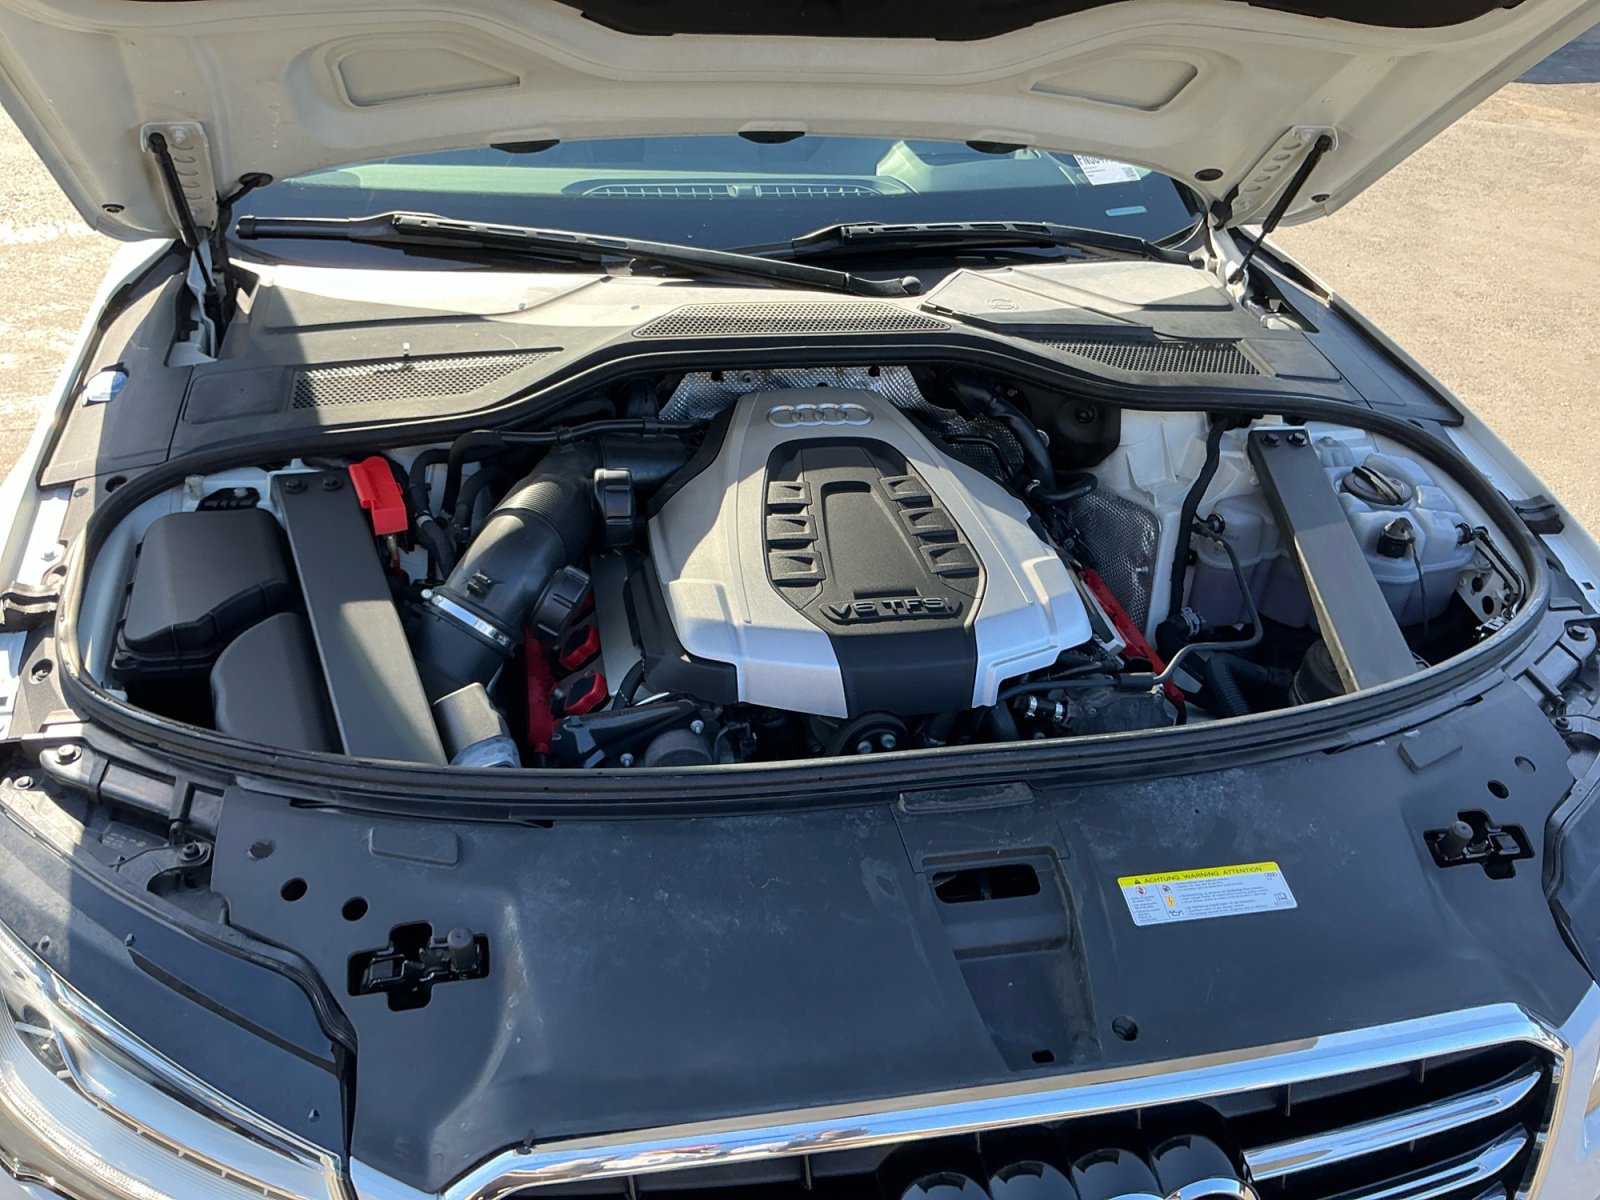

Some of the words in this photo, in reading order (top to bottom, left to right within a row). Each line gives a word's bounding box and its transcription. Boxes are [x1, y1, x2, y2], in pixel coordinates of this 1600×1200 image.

[828, 601, 878, 616] V6
[881, 597, 953, 613] TFSI
[1144, 875, 1180, 884] ACHTUNG
[1183, 870, 1219, 880] WARNING
[1223, 866, 1263, 876] ATTENTION
